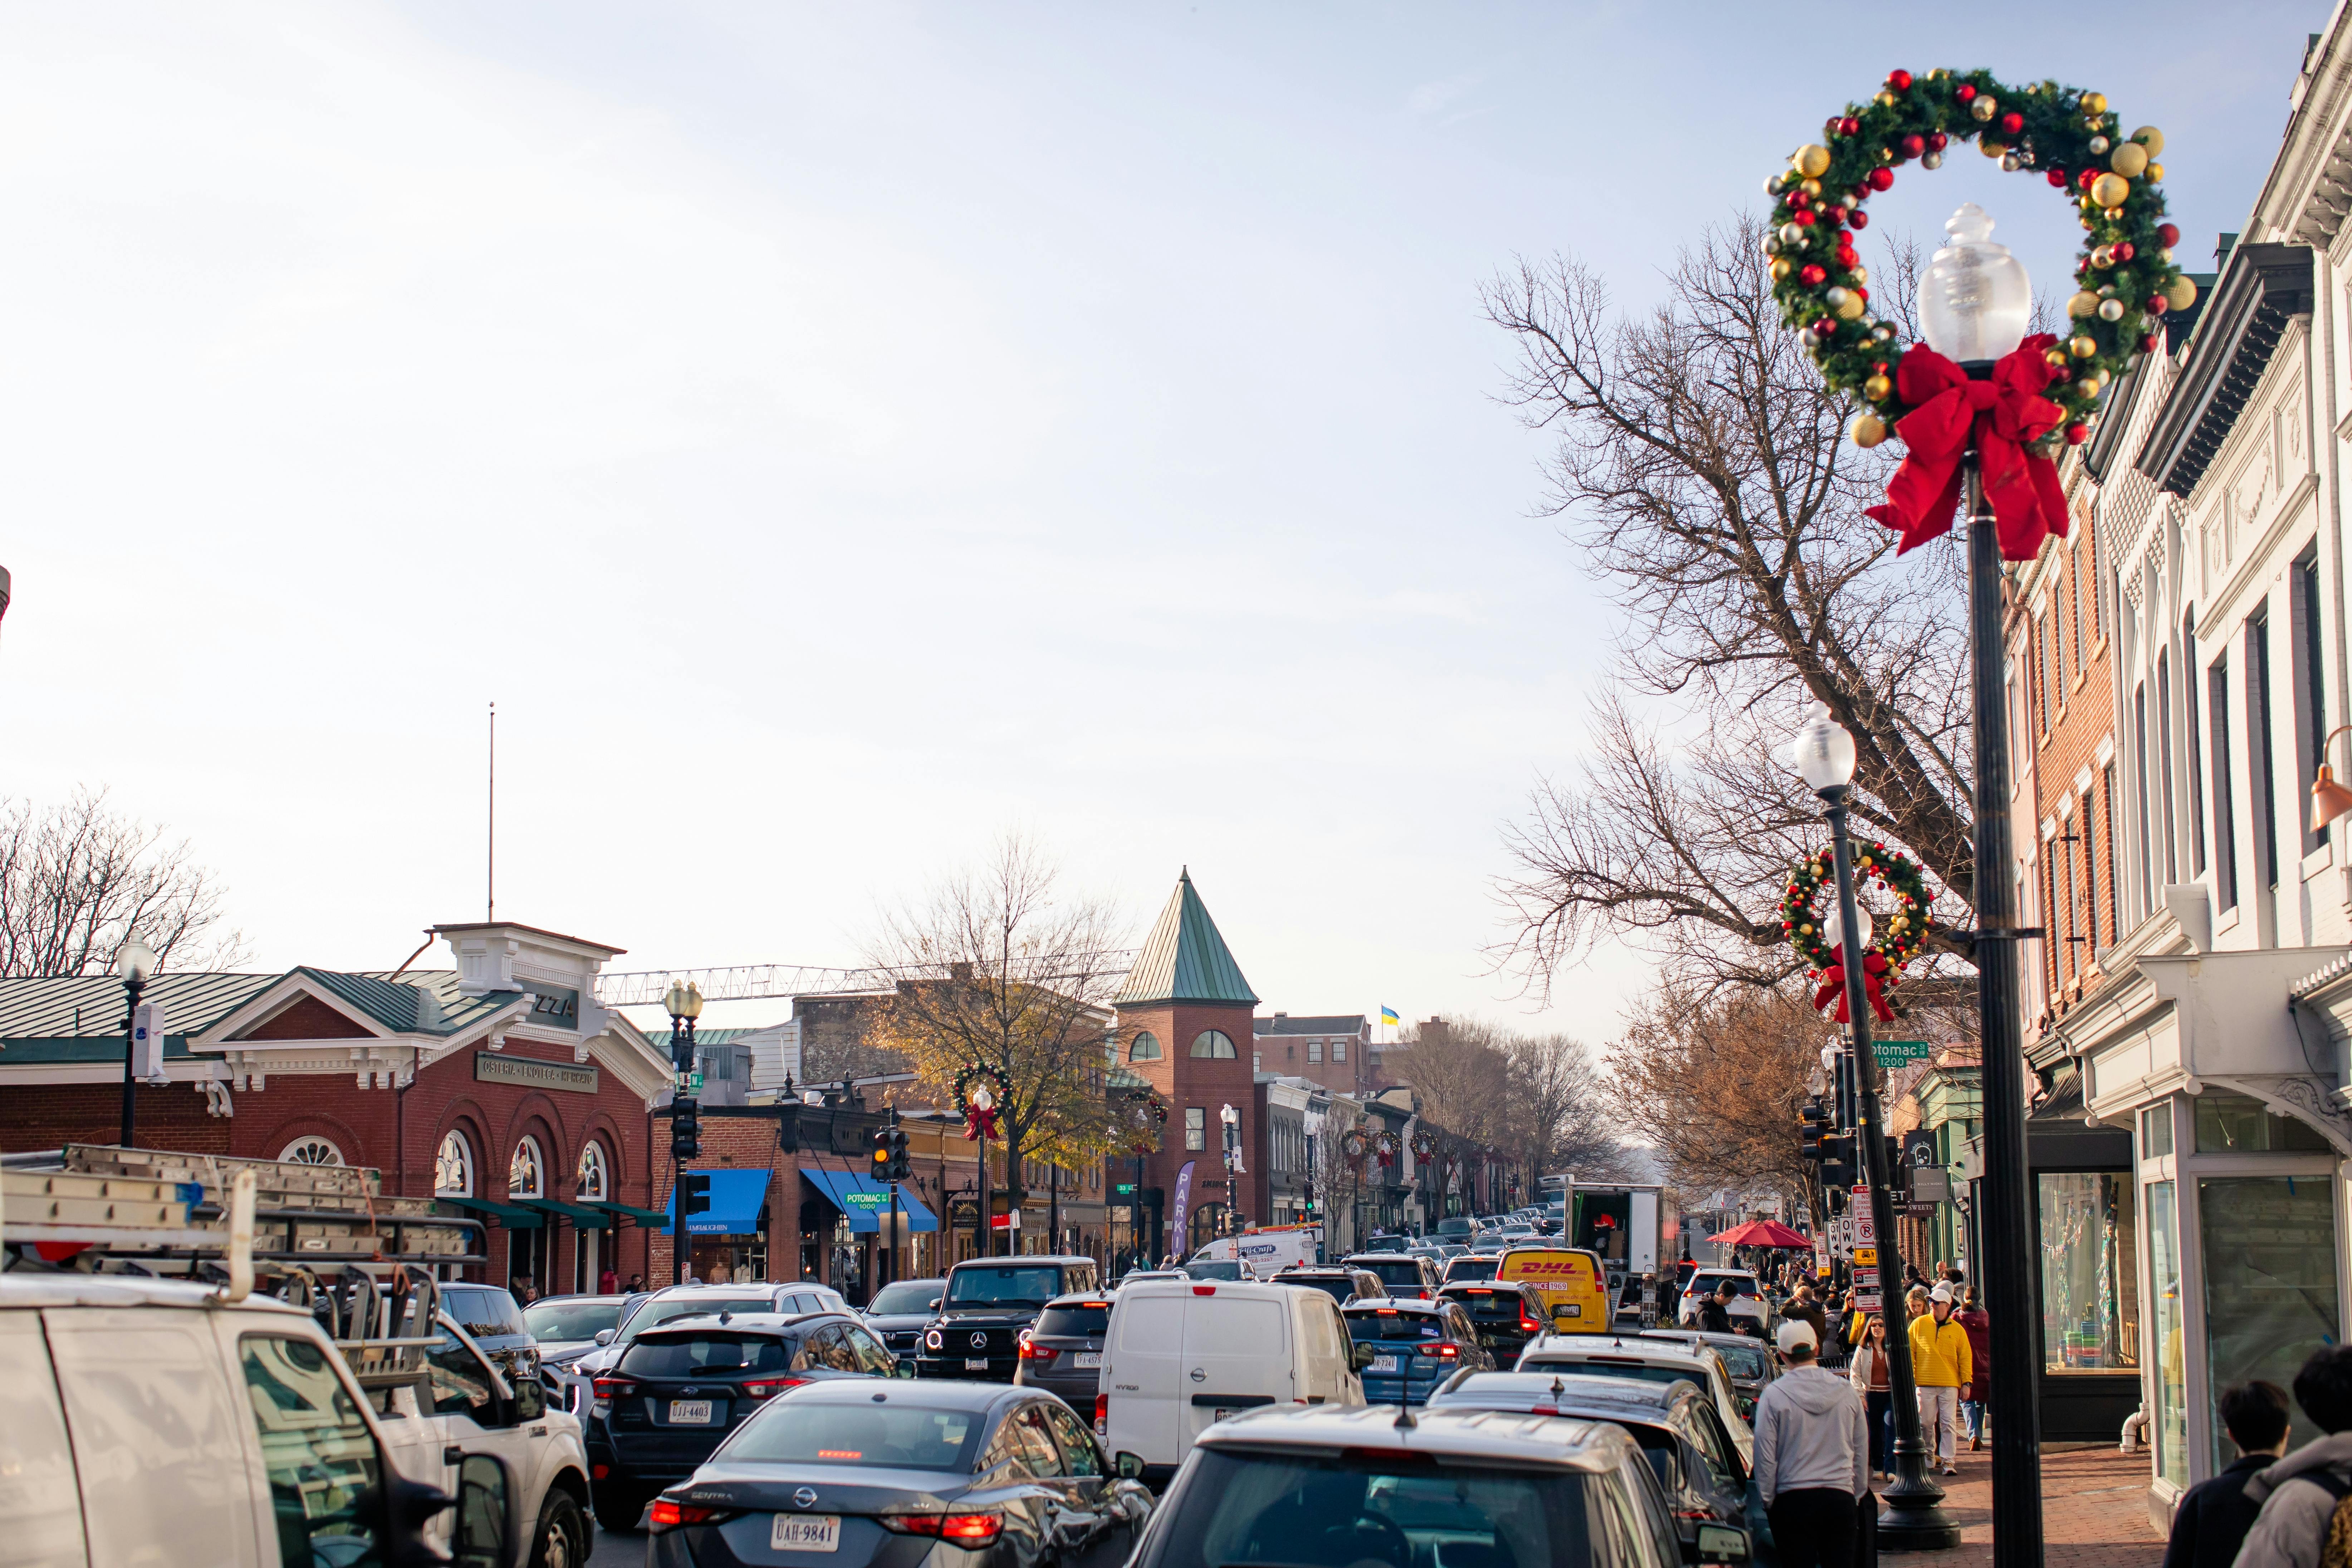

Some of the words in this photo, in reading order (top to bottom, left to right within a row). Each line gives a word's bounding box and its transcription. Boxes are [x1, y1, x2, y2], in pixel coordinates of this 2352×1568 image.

[533, 994, 574, 1018] ZZA
[1872, 1044, 1917, 1055] otomac
[1881, 1058, 1904, 1066] 1200
[484, 1060, 515, 1075] OSTERIA
[522, 1065, 555, 1080] ENOTECA
[561, 1070, 593, 1084] MERCATO
[692, 1076, 697, 1085] M
[1910, 1142, 1921, 1154] Bubble
[847, 1194, 881, 1202] POTOMAC
[1520, 1262, 1577, 1274] DHL
[672, 1406, 708, 1417] UJJ-4403
[691, 1491, 734, 1501] SENTRA
[776, 1523, 832, 1542] UAH-9841
